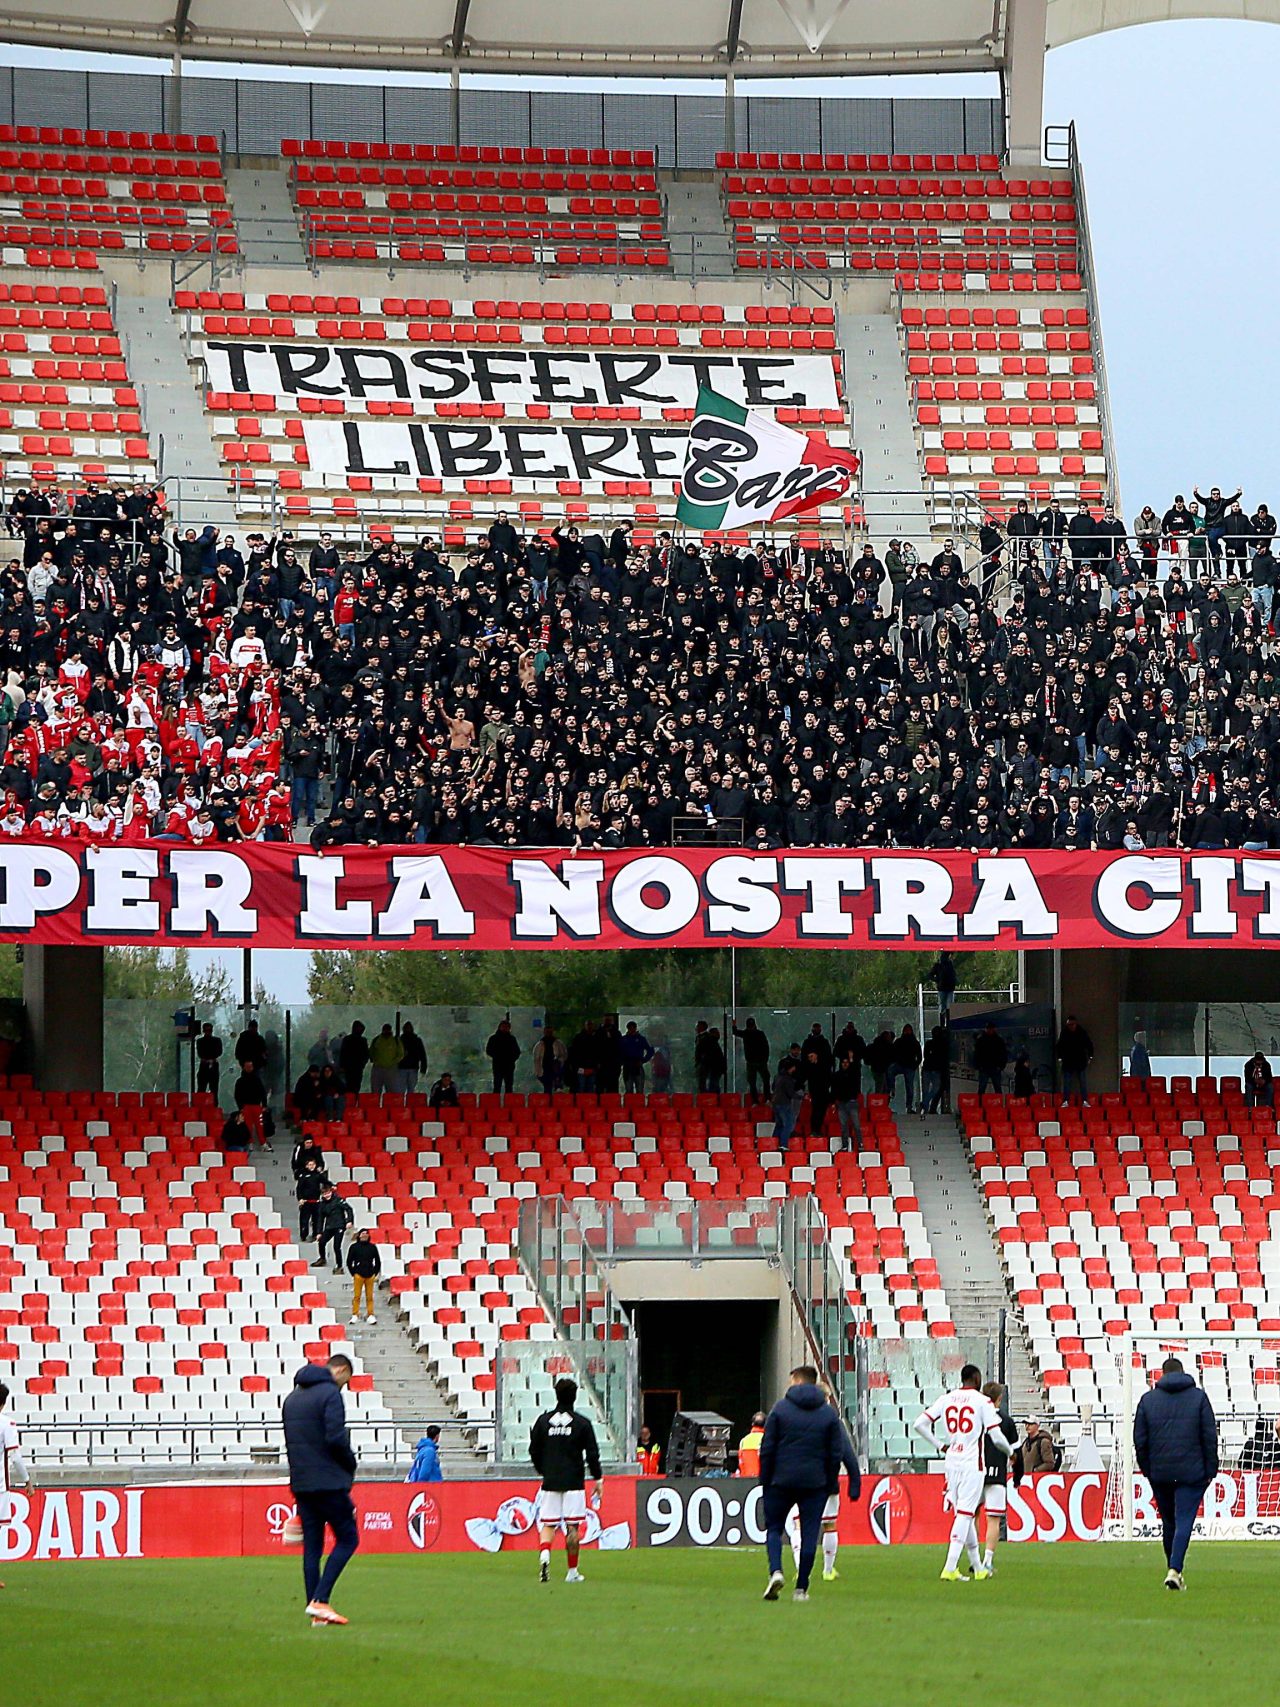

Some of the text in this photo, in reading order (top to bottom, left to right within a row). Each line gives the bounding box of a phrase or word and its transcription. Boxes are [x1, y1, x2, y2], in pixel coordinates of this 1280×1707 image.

[207, 341, 806, 406] TRASFERTE
[343, 420, 692, 480] LIBERE
[0, 845, 258, 934] PER
[298, 854, 476, 938] LA
[512, 855, 1059, 939] NOSTRA
[945, 1405, 975, 1434] 66
[1007, 1474, 1101, 1542] SSC
[1209, 1521, 1245, 1537] live
